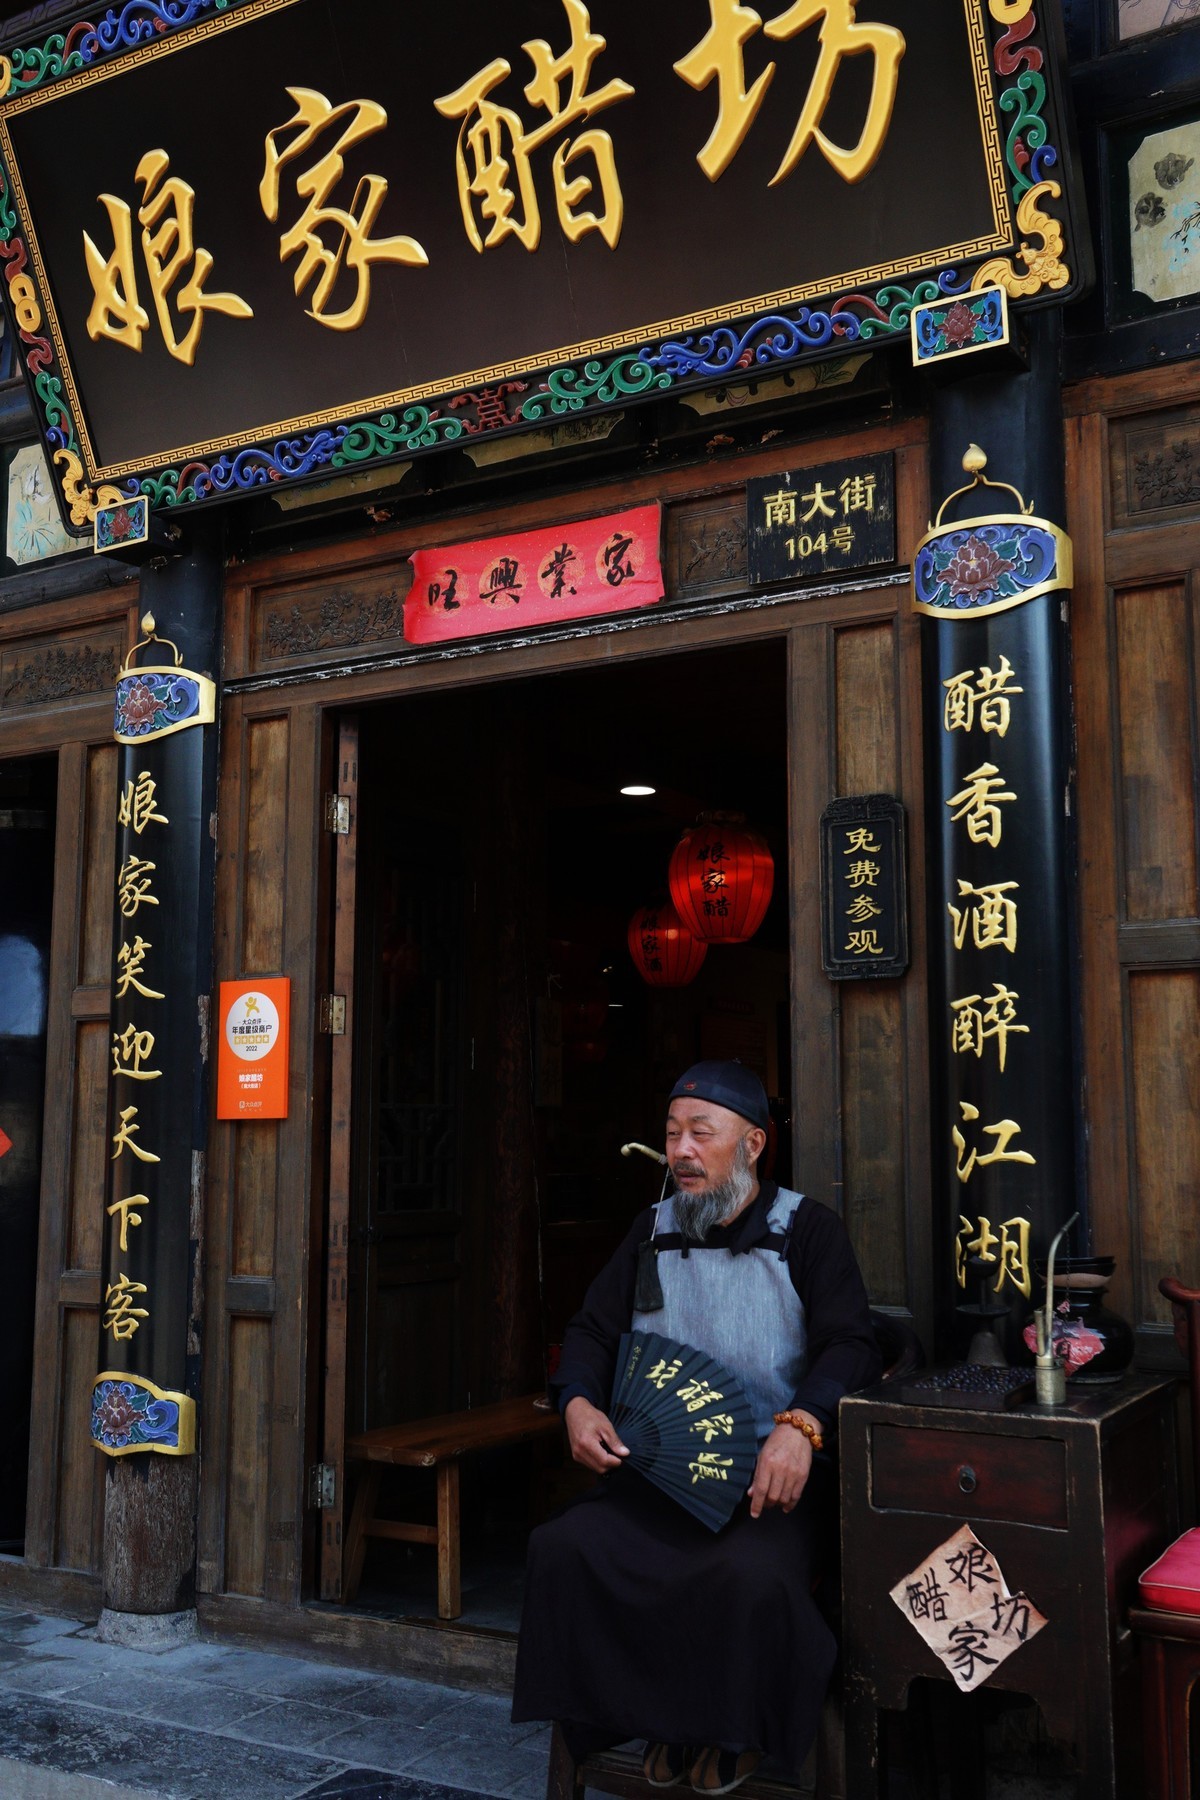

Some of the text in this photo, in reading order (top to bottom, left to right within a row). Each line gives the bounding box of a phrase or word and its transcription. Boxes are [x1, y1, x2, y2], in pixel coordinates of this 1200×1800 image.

[83, 0, 906, 367] 娘家醋坊
[763, 473, 877, 528] 南大街
[785, 525, 855, 560] 104号
[697, 842, 730, 917] 娘家醋
[843, 828, 883, 954] 免费参观
[943, 654, 1037, 1300] 醋香酒醉江湖
[103, 771, 169, 1341] 娘家笑迎天下客
[232, 1025, 272, 1034] 年度星级商户
